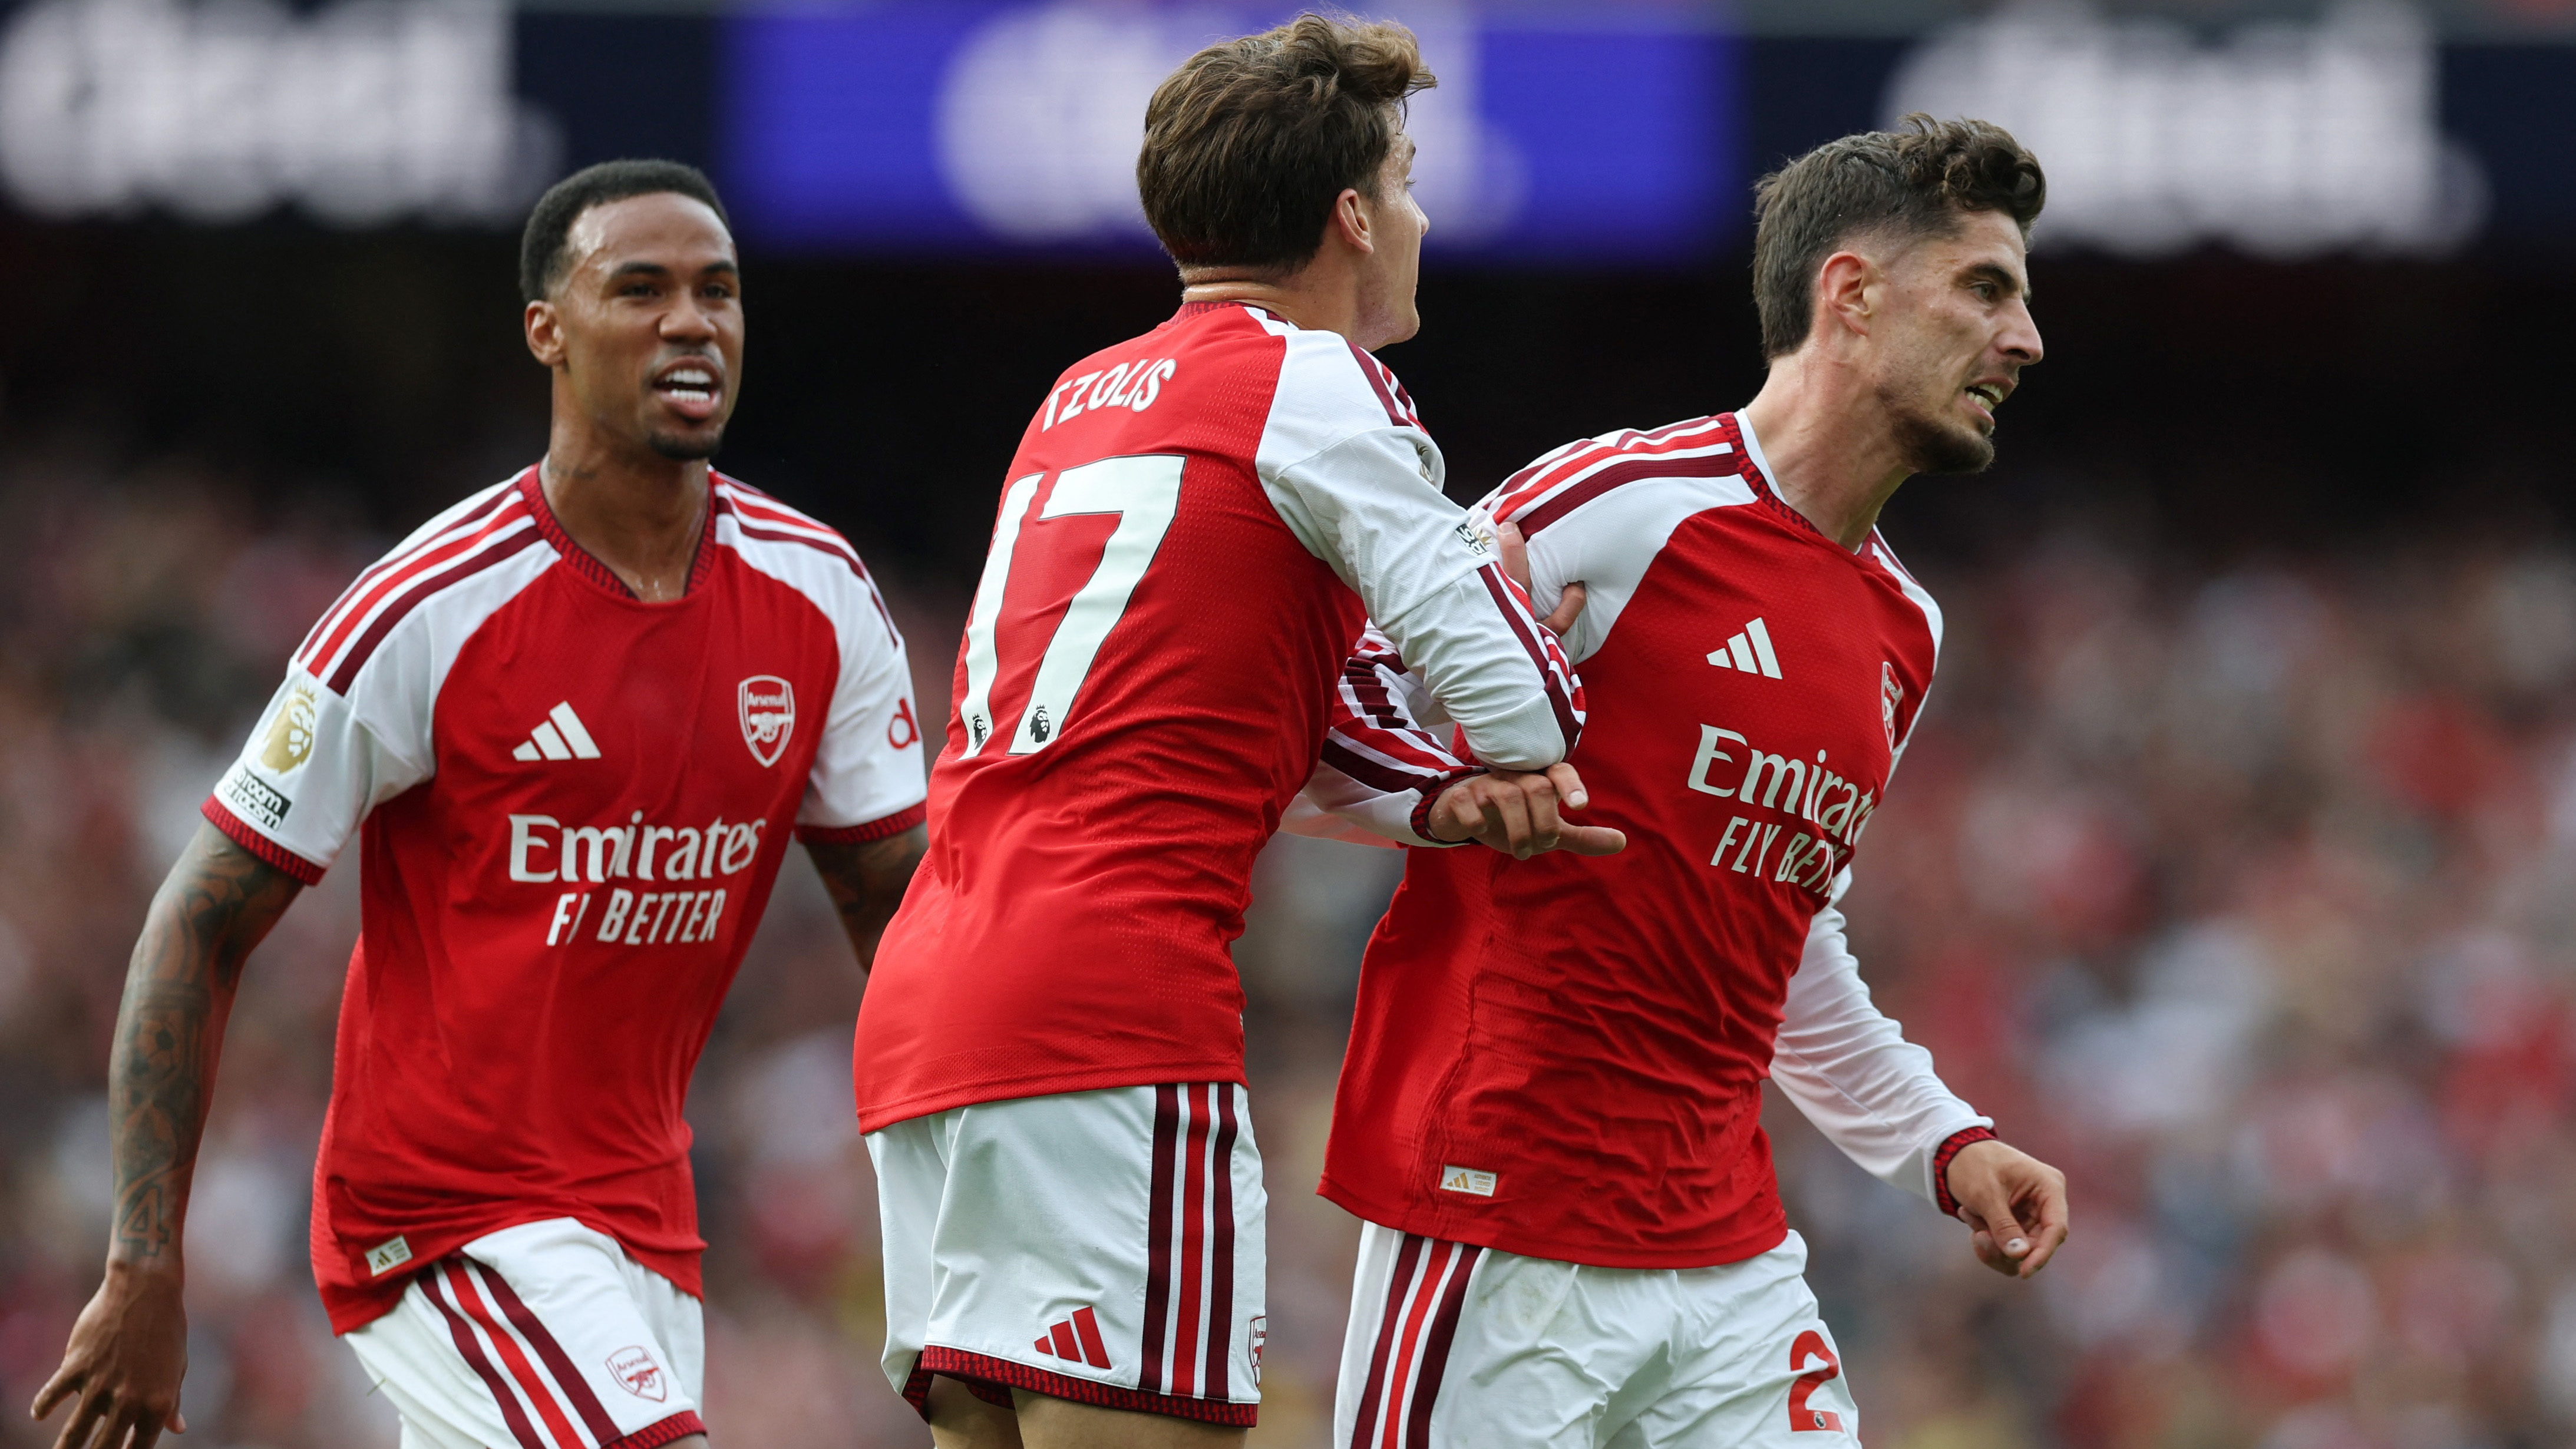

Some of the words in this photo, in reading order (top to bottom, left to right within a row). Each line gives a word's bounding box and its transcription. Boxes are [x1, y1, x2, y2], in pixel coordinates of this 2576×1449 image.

[1042, 358, 1177, 432] TZOLIS
[957, 454, 1188, 760] 17
[242, 775, 282, 813] room
[1687, 723, 1874, 846] Emirat
[508, 810, 767, 882] Emirates
[1710, 816, 1782, 877] FLY
[597, 888, 726, 945] BETTER
[1788, 1329, 1844, 1433] 2
